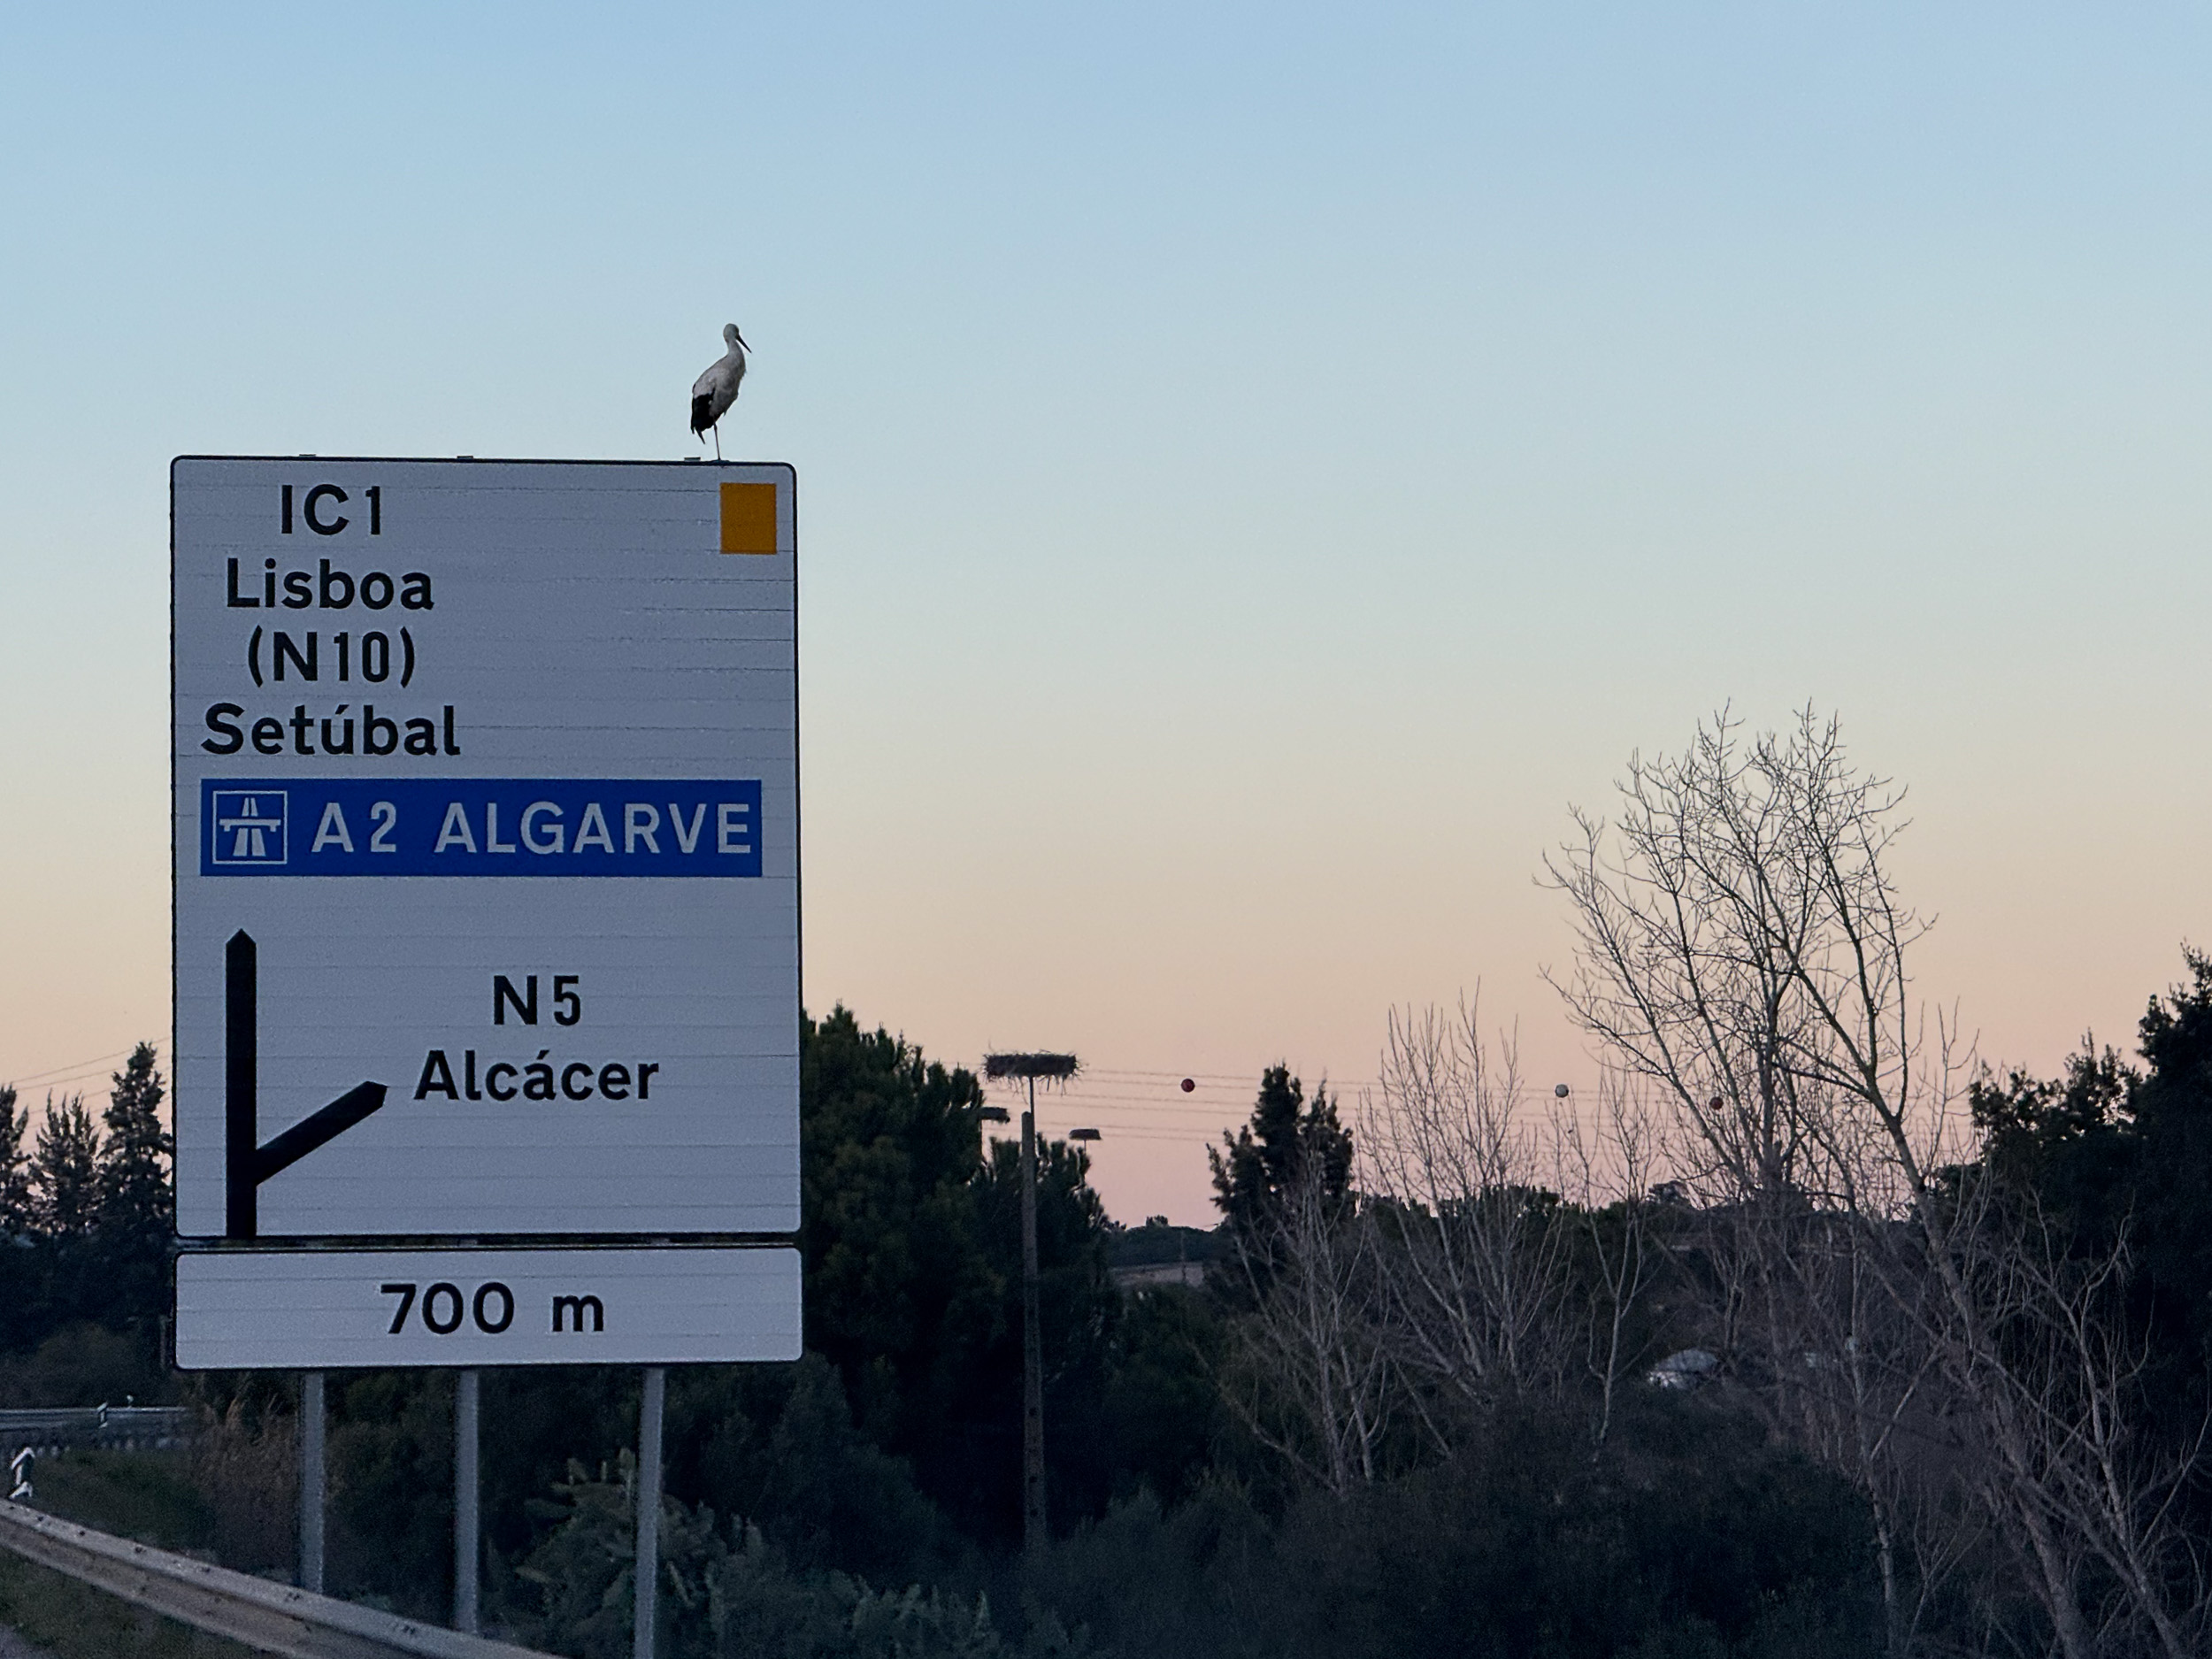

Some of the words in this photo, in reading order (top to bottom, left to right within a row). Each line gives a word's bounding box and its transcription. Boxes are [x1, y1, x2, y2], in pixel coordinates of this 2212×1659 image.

[227, 557, 435, 611] Lisboa
[248, 625, 415, 688] (N10)
[200, 702, 461, 757] Setúbal
[434, 801, 751, 855] ALGARVE
[413, 1049, 659, 1102] Alcácer
[380, 1281, 515, 1335] 700
[552, 1294, 604, 1333] m
